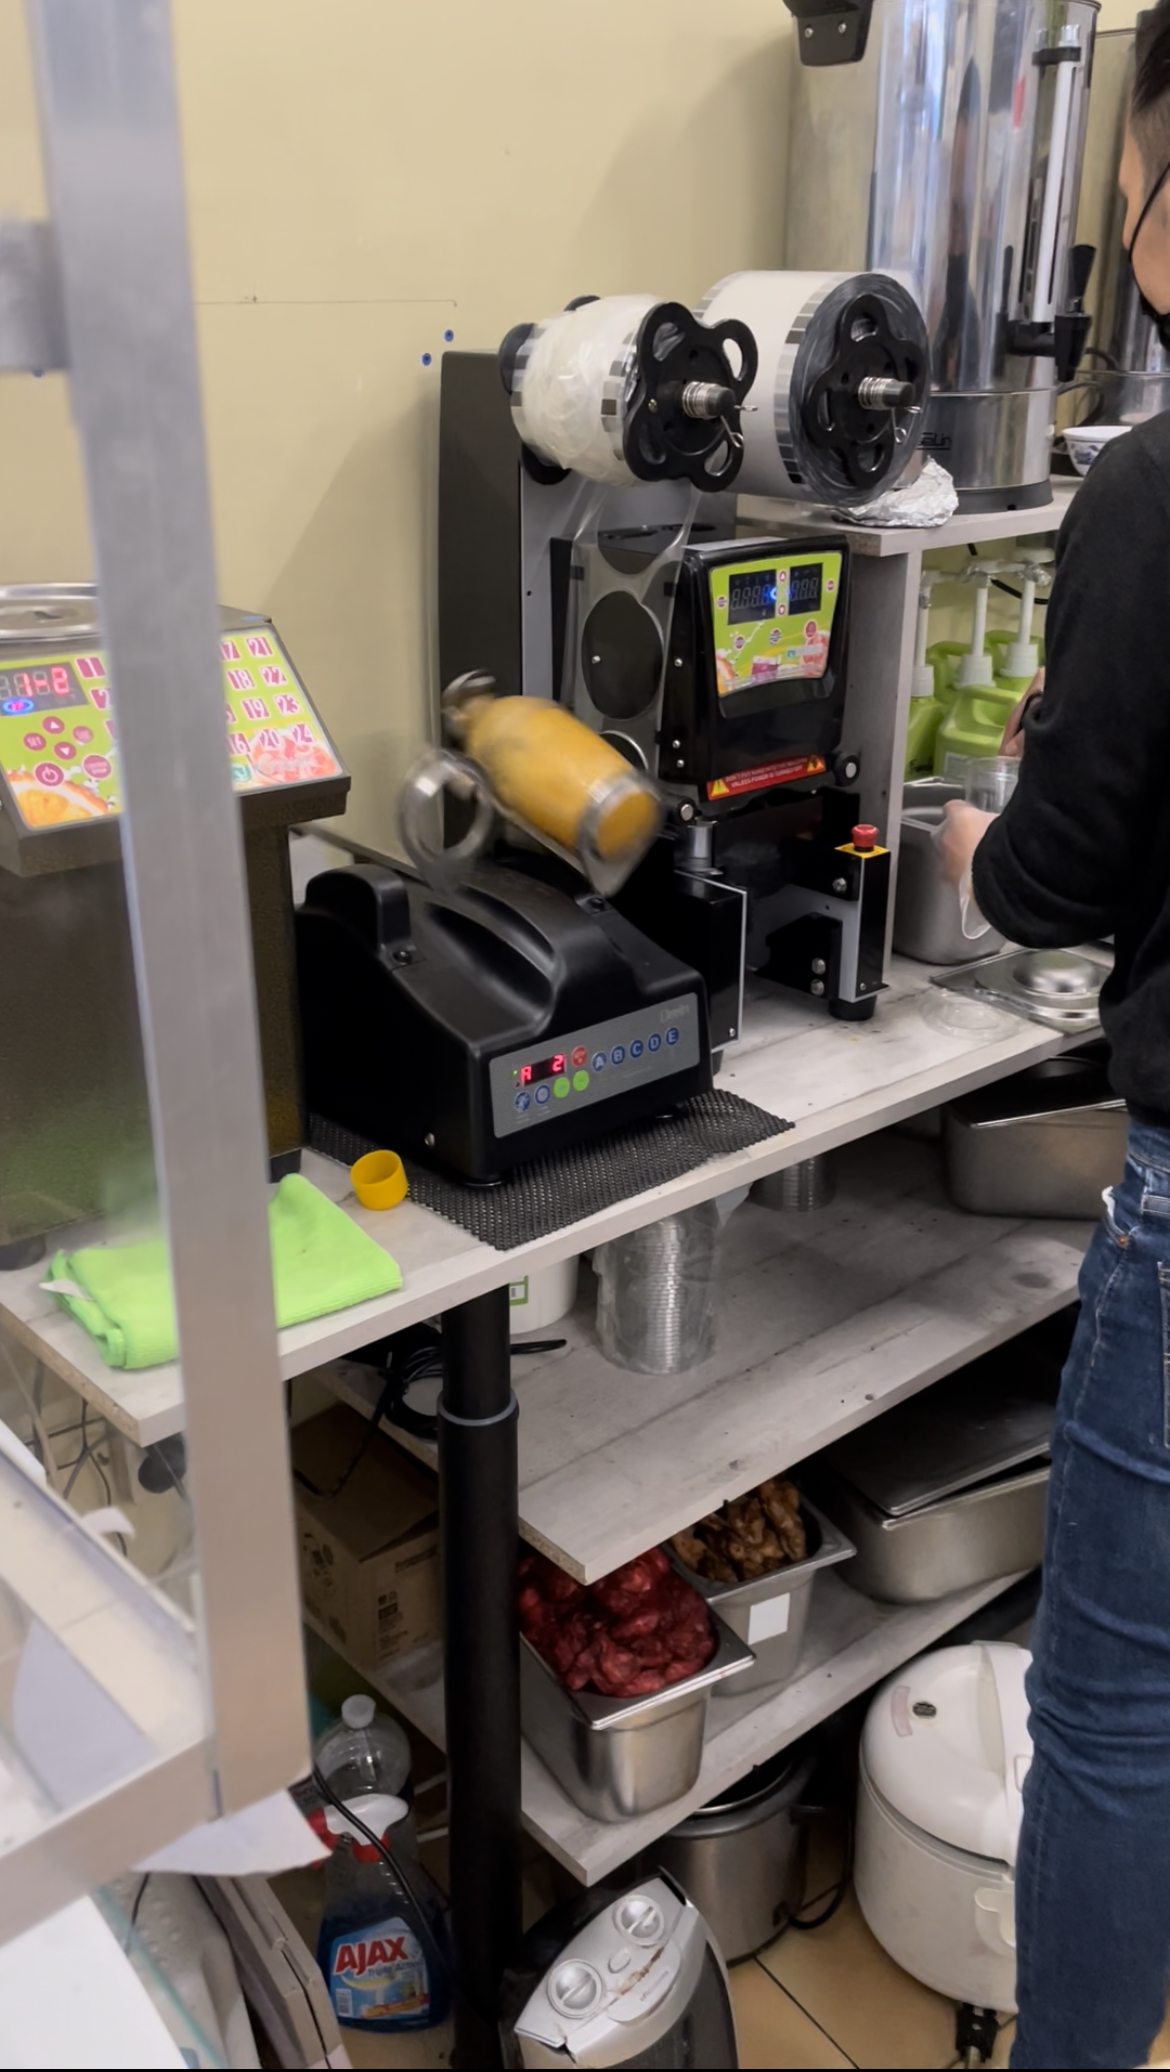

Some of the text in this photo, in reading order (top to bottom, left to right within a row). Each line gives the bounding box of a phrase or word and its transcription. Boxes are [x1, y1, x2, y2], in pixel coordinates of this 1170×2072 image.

[249, 638, 271, 656] 21
[232, 667, 287, 689] 18 22
[246, 699, 268, 718] 19
[276, 696, 299, 713] 23
[259, 730, 280, 749] 20
[291, 725, 313, 744] 24
[552, 1054, 564, 1071] 2
[335, 1936, 409, 1976] AJAX
